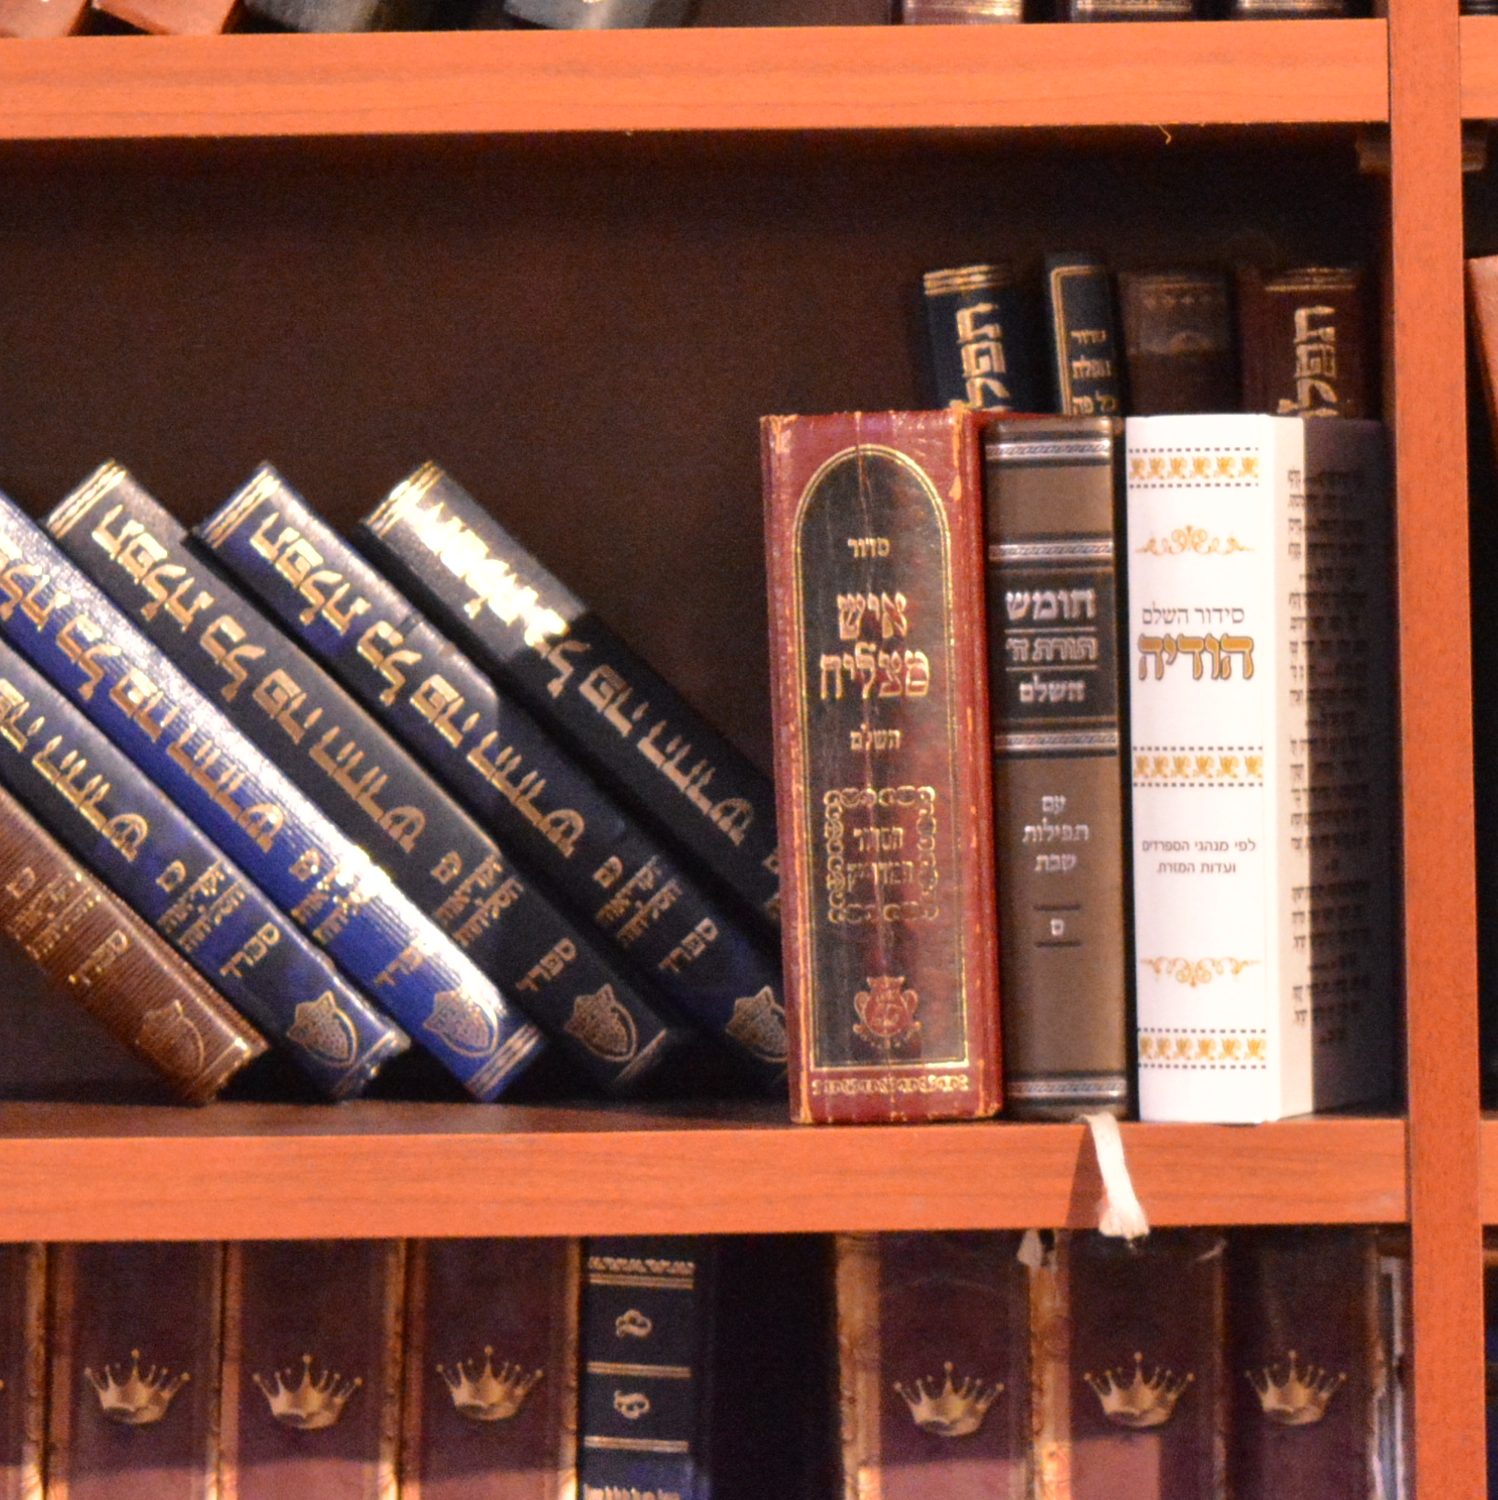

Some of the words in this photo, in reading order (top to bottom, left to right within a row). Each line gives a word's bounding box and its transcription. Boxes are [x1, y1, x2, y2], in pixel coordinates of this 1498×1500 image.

[849, 537, 889, 558] סדור
[838, 594, 907, 641] איש
[1006, 588, 1096, 622] חומש
[1142, 601, 1191, 625] השלם
[1198, 606, 1244, 625] סידור
[1032, 635, 1097, 664] תורת
[1138, 634, 1254, 681] הודיה
[251, 511, 370, 634] תפלת
[358, 620, 422, 707] כל
[410, 674, 478, 746] פה
[466, 730, 585, 857] החדש
[820, 643, 930, 699] מצליח
[1019, 677, 1085, 704] השלם
[851, 723, 901, 749] השלם
[32, 735, 148, 861] החדש
[1041, 794, 1066, 812] עם
[1022, 818, 1089, 844] תפילות
[1142, 838, 1189, 855] הספרדים
[1192, 838, 1230, 853] מנהגי
[1234, 838, 1256, 855] לפי
[1034, 852, 1077, 874] שבת
[1202, 861, 1237, 876] ועדות
